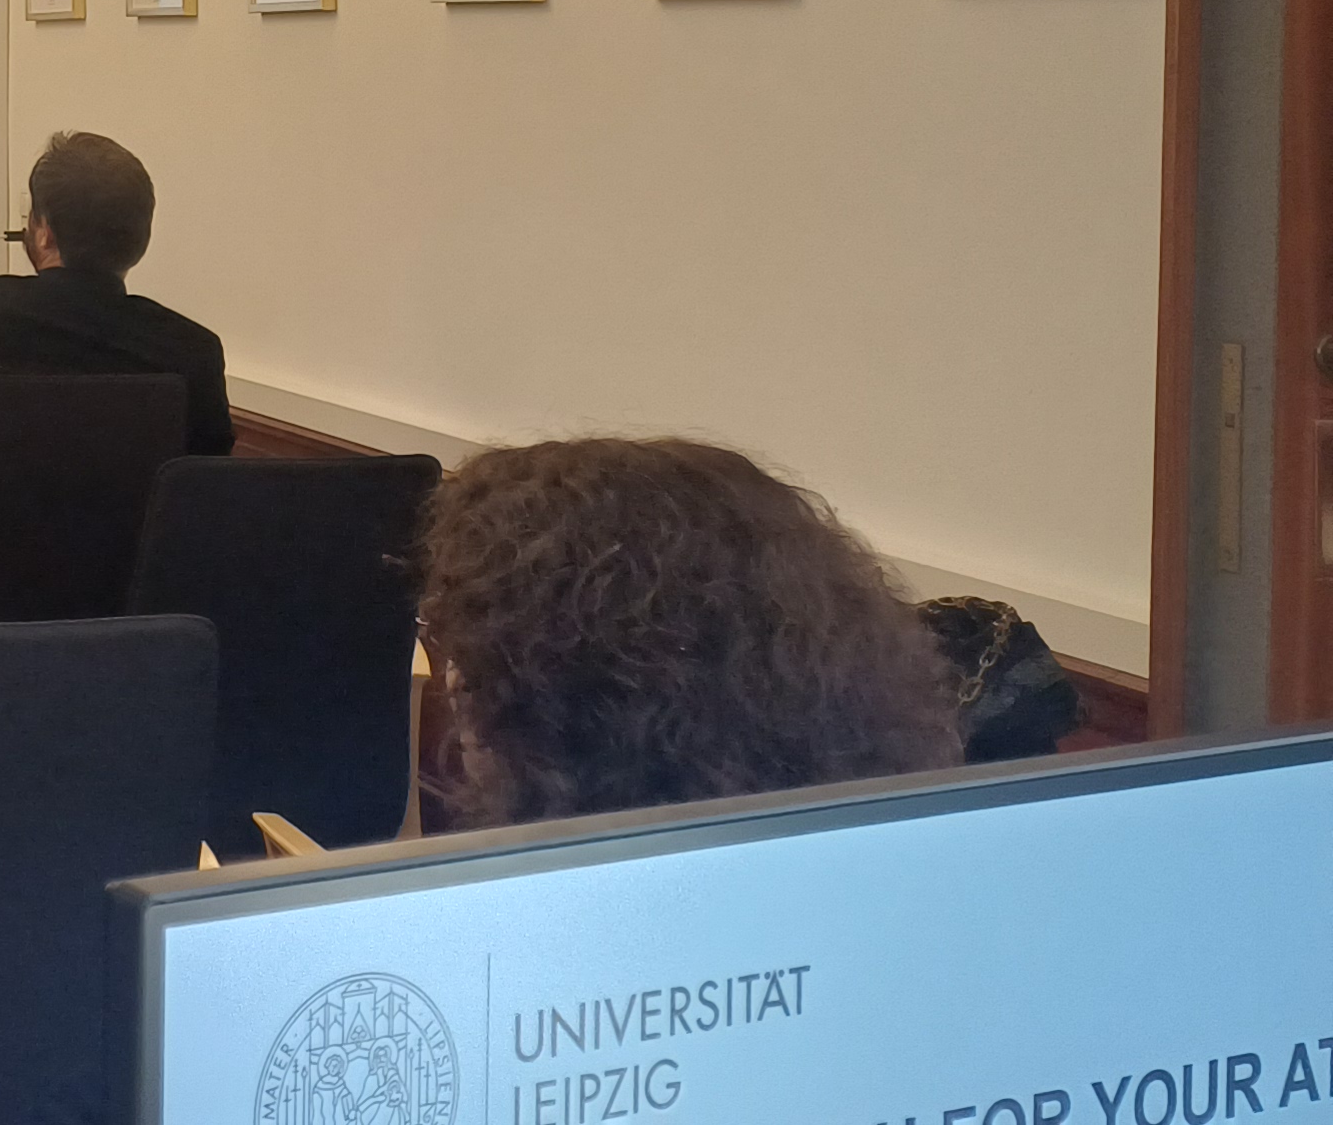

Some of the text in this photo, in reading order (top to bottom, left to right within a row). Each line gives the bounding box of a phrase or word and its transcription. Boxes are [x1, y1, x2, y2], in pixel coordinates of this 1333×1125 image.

[513, 965, 812, 1063] UNIVERSITÄT
[262, 1020, 453, 1125] MATER LIPSIEN
[514, 1058, 682, 1125] LEIPZIG
[1091, 1052, 1266, 1125] YOUR
